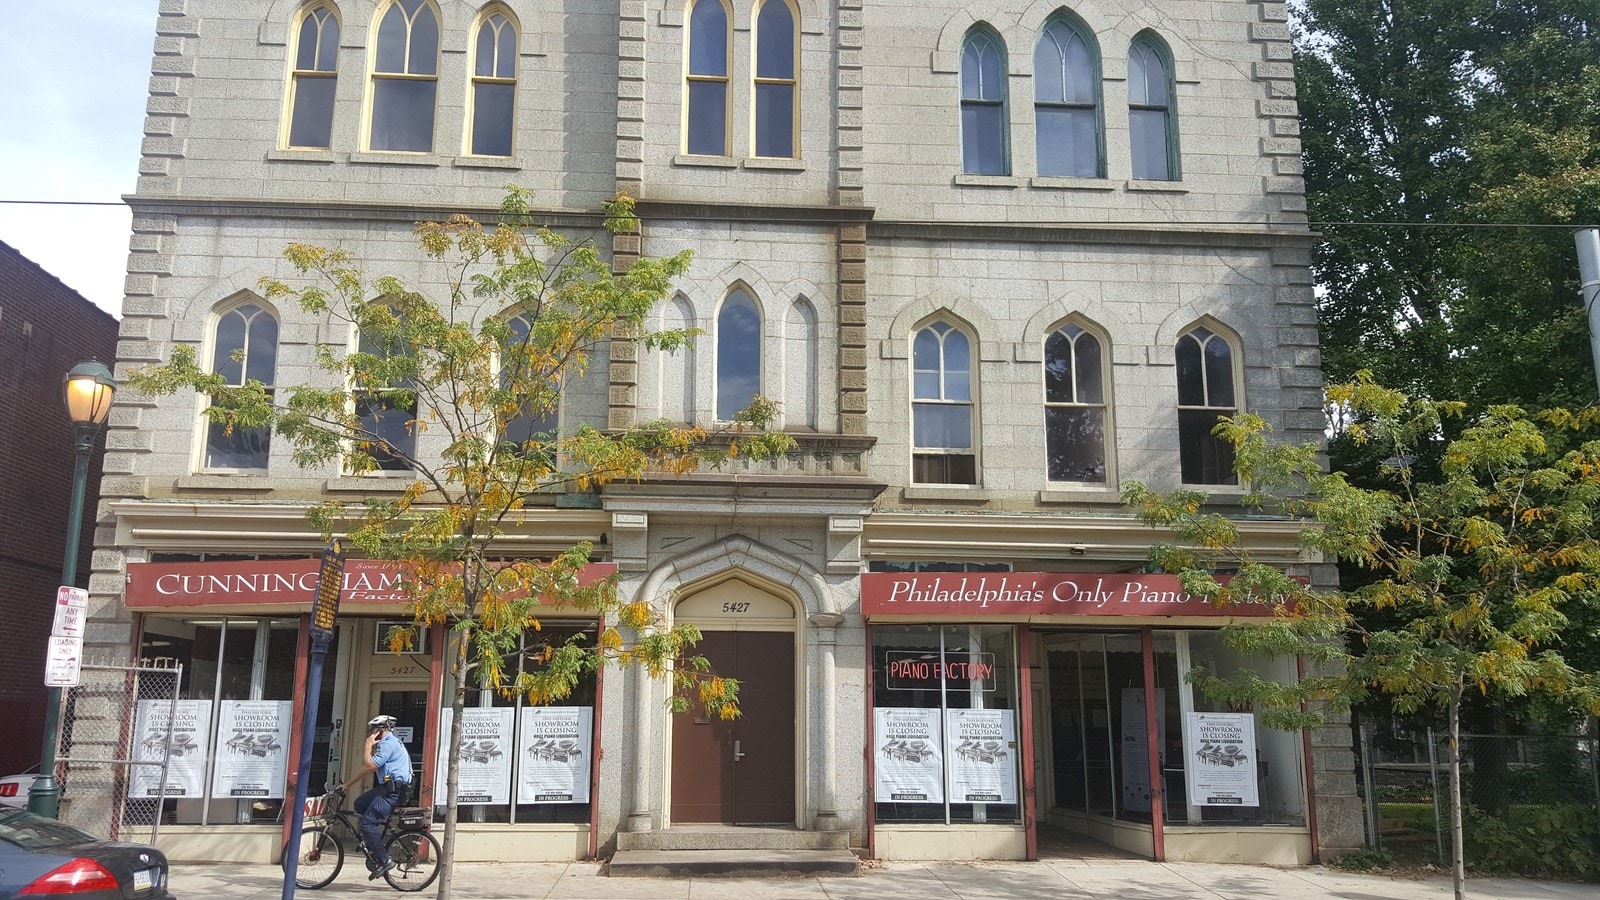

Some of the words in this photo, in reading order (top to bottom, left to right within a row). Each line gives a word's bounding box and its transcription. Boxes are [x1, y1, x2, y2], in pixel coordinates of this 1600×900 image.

[60, 592, 68, 601] NO
[888, 577, 1044, 608] Philadelphia's
[1052, 577, 1114, 608] Only
[1120, 582, 1190, 604] Piano
[65, 608, 79, 616] ANY
[722, 602, 751, 613] 5427
[64, 616, 78, 625] TIME
[390, 666, 415, 675] 5427
[890, 661, 929, 680] PIANO
[933, 662, 993, 680] FACTORY
